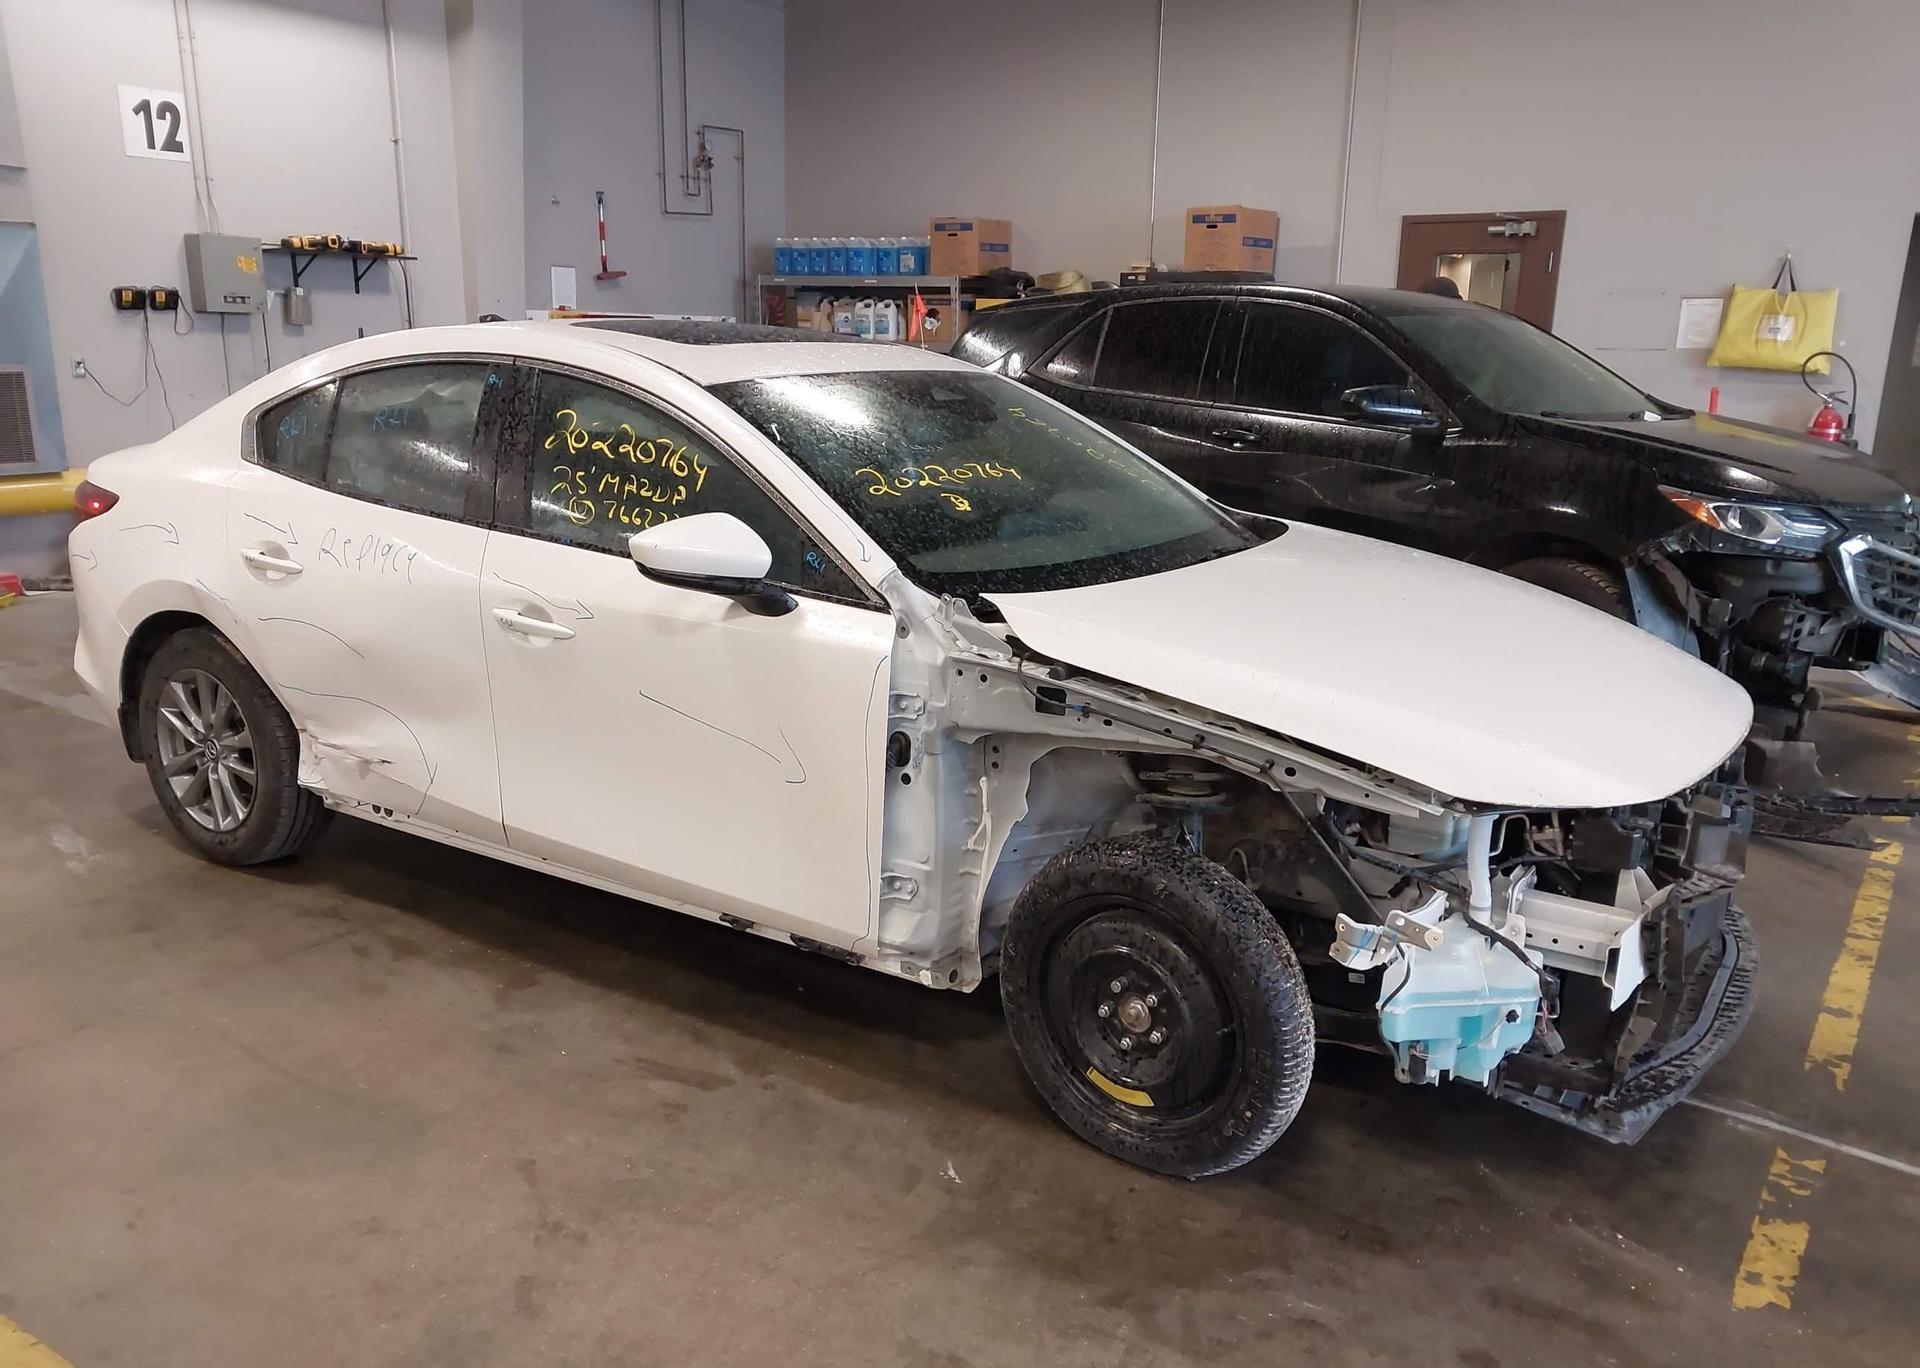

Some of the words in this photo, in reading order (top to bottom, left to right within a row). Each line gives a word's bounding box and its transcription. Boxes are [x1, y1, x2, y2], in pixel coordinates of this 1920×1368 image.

[132, 98, 184, 154] 12
[544, 409, 708, 493] 20220764
[855, 462, 1022, 496] 20220764
